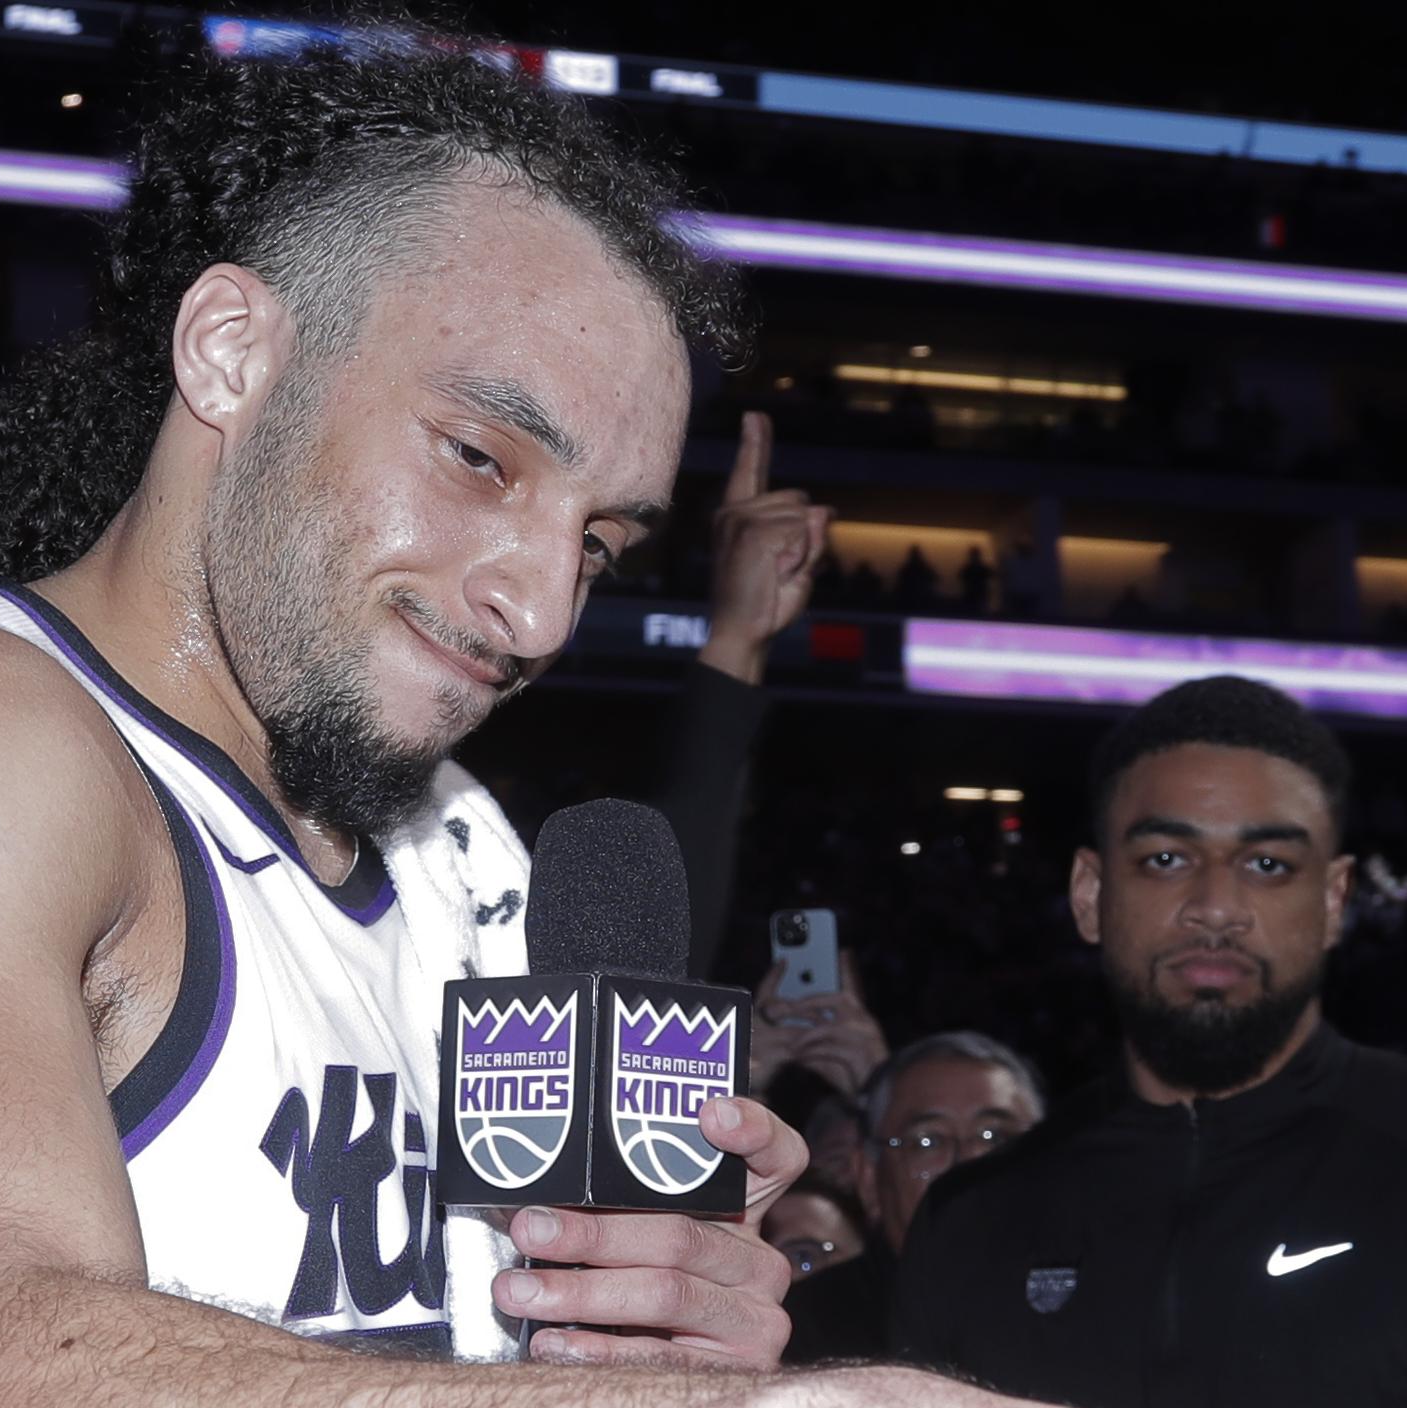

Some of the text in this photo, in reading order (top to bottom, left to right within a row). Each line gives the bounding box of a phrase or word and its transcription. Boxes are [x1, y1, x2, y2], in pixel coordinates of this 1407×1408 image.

[643, 613, 711, 648] FIN
[463, 1050, 568, 1068] SACRAMENTO
[620, 1052, 727, 1077] SACRAMENTO
[459, 1074, 570, 1112] KINGS
